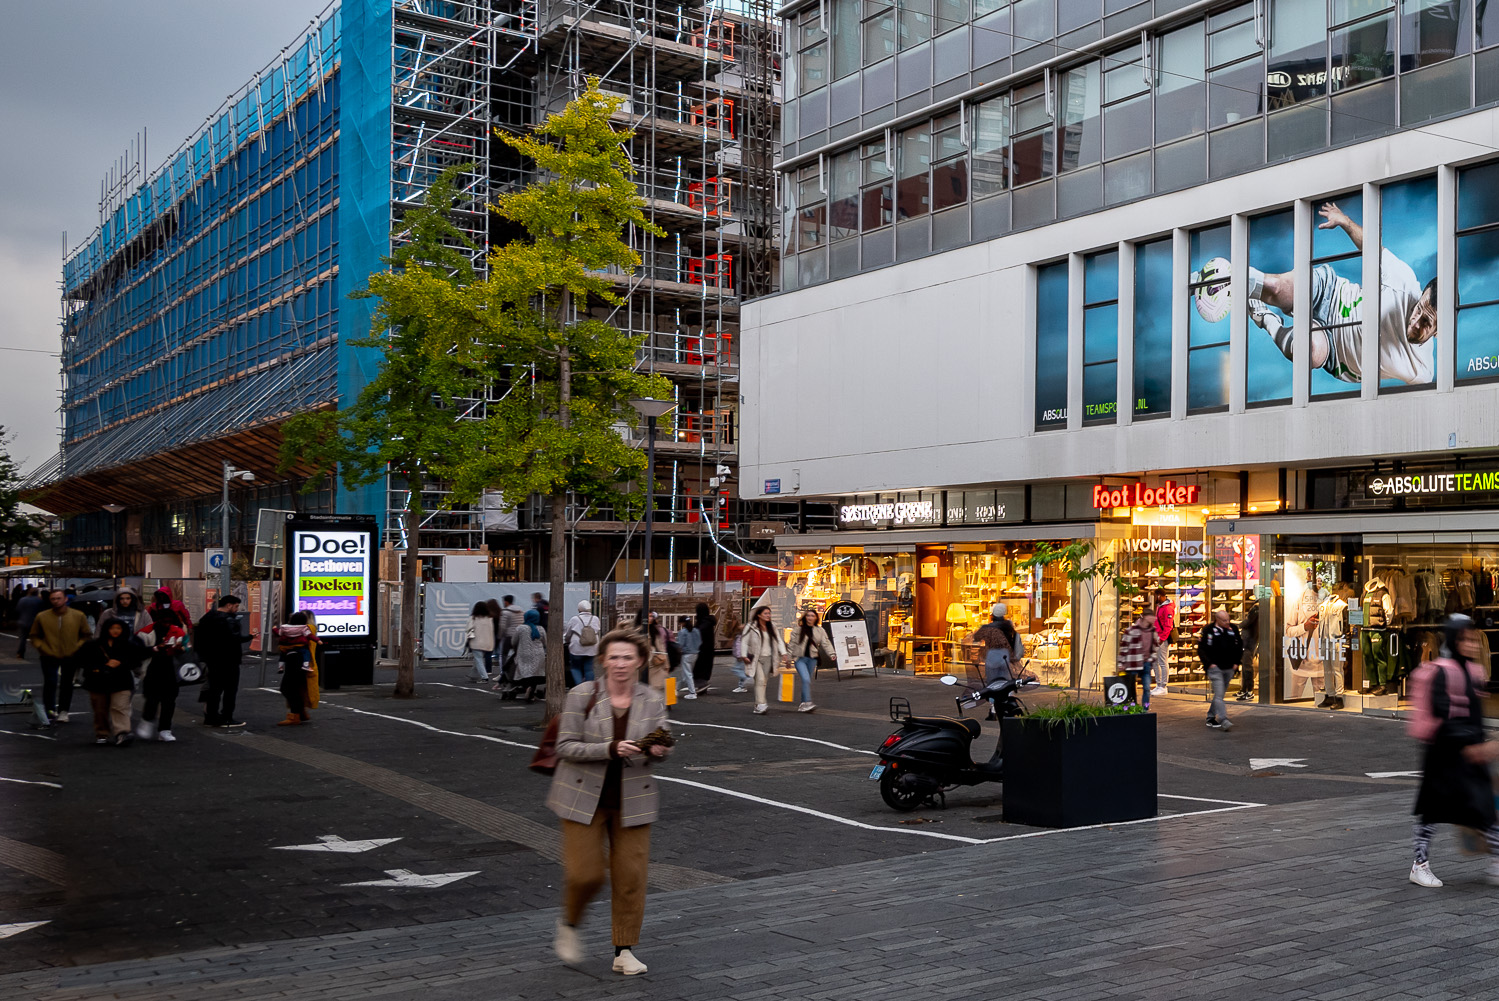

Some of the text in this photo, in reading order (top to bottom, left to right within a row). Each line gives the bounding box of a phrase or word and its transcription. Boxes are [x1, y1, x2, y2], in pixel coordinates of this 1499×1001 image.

[1093, 479, 1200, 509] Foot Locker
[299, 533, 366, 554] Doe!
[1131, 538, 1182, 553] WOMEN
[301, 559, 363, 573] Beethoven
[302, 578, 363, 591] Boeken
[299, 600, 357, 610] Bubbels
[317, 622, 366, 633] Doelen
[1282, 634, 1347, 662] EQUALITÉ
